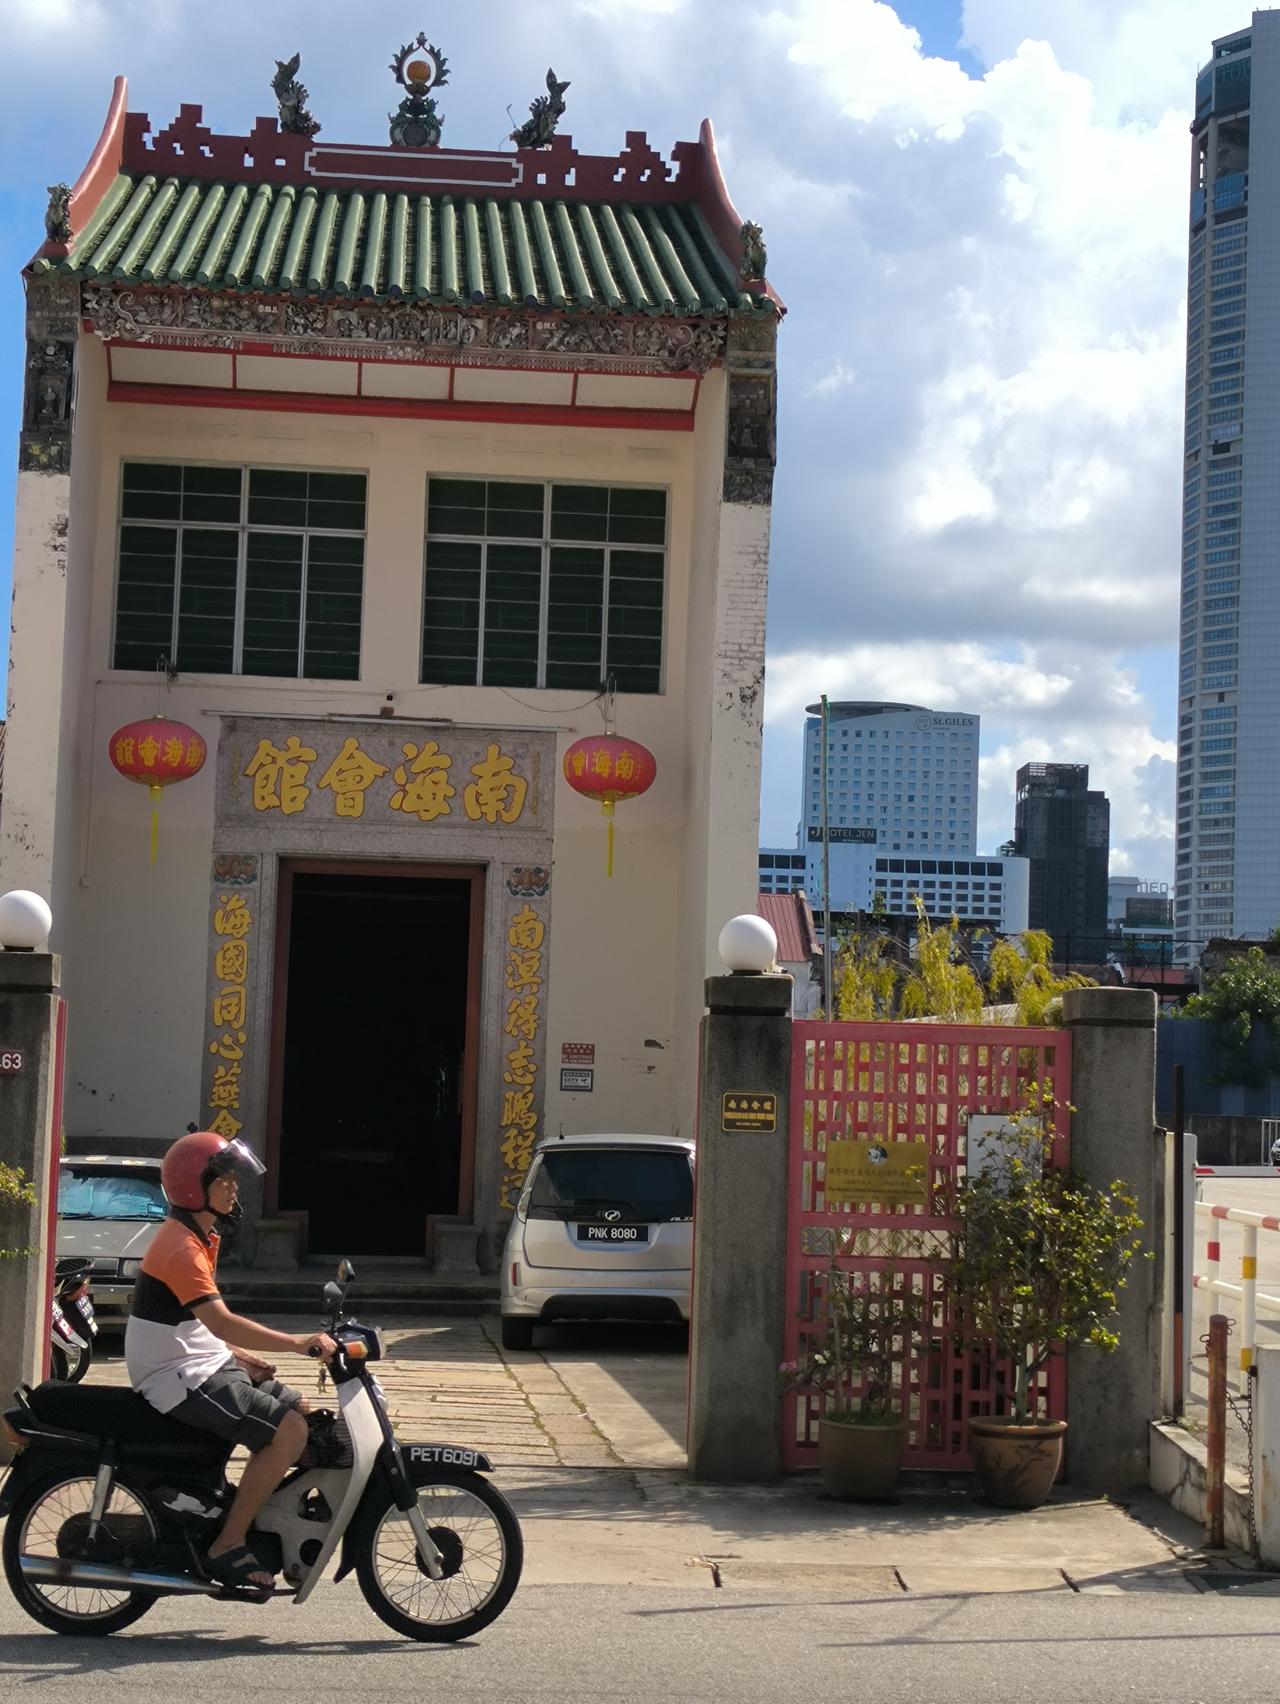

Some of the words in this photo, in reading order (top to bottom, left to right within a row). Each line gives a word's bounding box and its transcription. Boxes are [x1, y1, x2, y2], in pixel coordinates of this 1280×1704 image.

[828, 828, 854, 838] OTEL
[588, 1227, 608, 1239] PNK
[610, 1228, 638, 1239] 8080
[410, 1447, 479, 1467] PET6091
